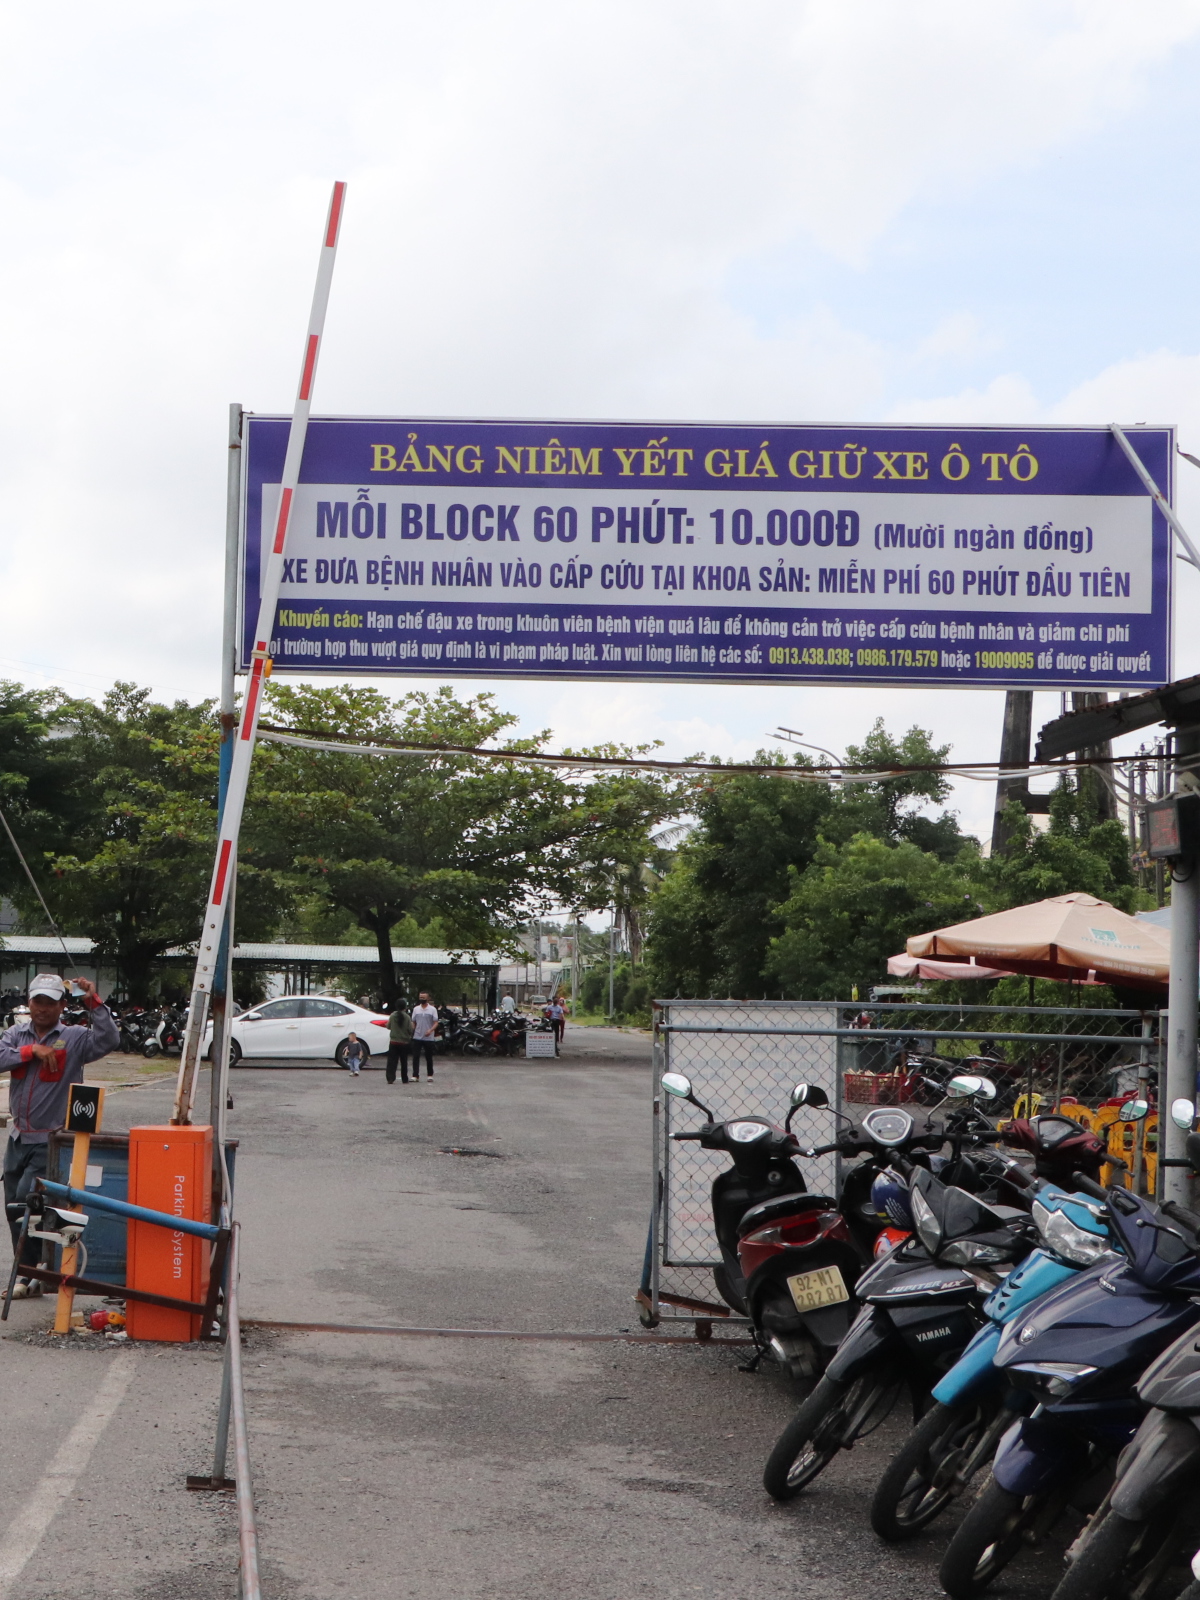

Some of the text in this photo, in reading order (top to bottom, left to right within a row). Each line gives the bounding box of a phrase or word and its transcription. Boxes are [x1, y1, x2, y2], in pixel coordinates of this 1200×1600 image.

[371, 433, 1038, 481] BẢNG NIÊM YẾT GIÁ GIỮ XE Ô TÔ
[317, 488, 1092, 553] MỖI BLOCK 60 PHÚT: 10.000Đ (Mười ngàn đồng)
[282, 555, 1130, 597] XE ĐƯA BỆNH NHÂN VÀO CẤP CỨU TẠI KHOA SẢN: MIỄN PHÍ 60 PHÚT ĐẦU TIÊN
[280, 608, 1129, 643] Khuyến cáo: Hạn chế đậu xe trong khuôn viên bệnh viện quá lâu để không cản trở việc cấp cứu bệnh nhân và giảm chi phí
[270, 638, 1150, 673] ọi trường hợp thu vượt giá quy định là vi phạm pháp luật. Xin vui lòng liên hệ các số: 0913.438.038; 0986.179.579 hoặc 19009095 để được giải quyết
[172, 1175, 185, 1279] Parkin System
[796, 1270, 835, 1292] 92-N1
[886, 1280, 942, 1294] JUPITER
[915, 1326, 952, 1343] YAMAHA
